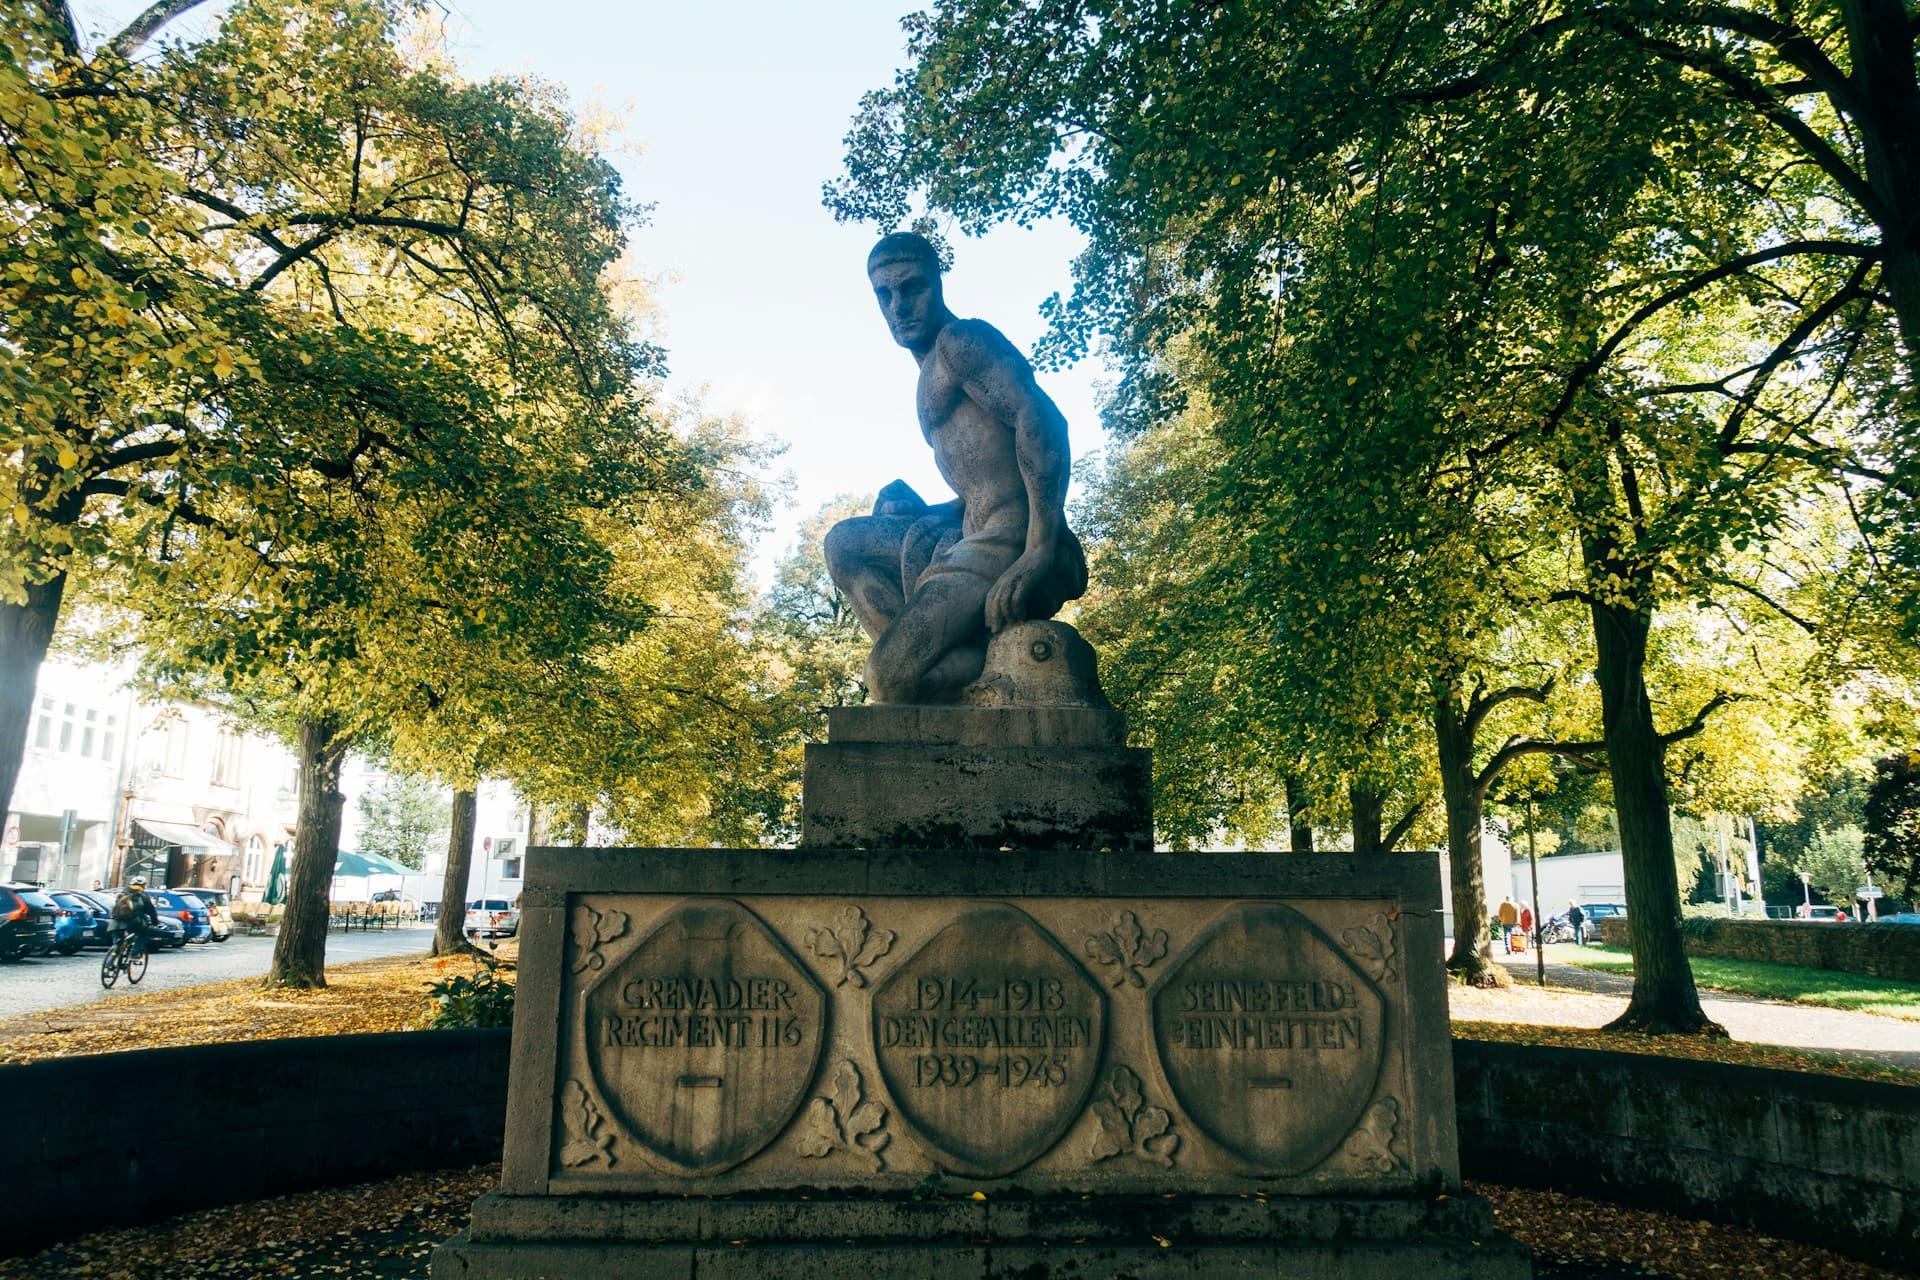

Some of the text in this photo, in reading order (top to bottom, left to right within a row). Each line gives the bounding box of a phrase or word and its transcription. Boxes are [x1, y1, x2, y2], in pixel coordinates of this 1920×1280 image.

[604, 1015, 802, 1047] REGIMENT 116
[880, 1015, 1092, 1048] DEN GEFALLENEN
